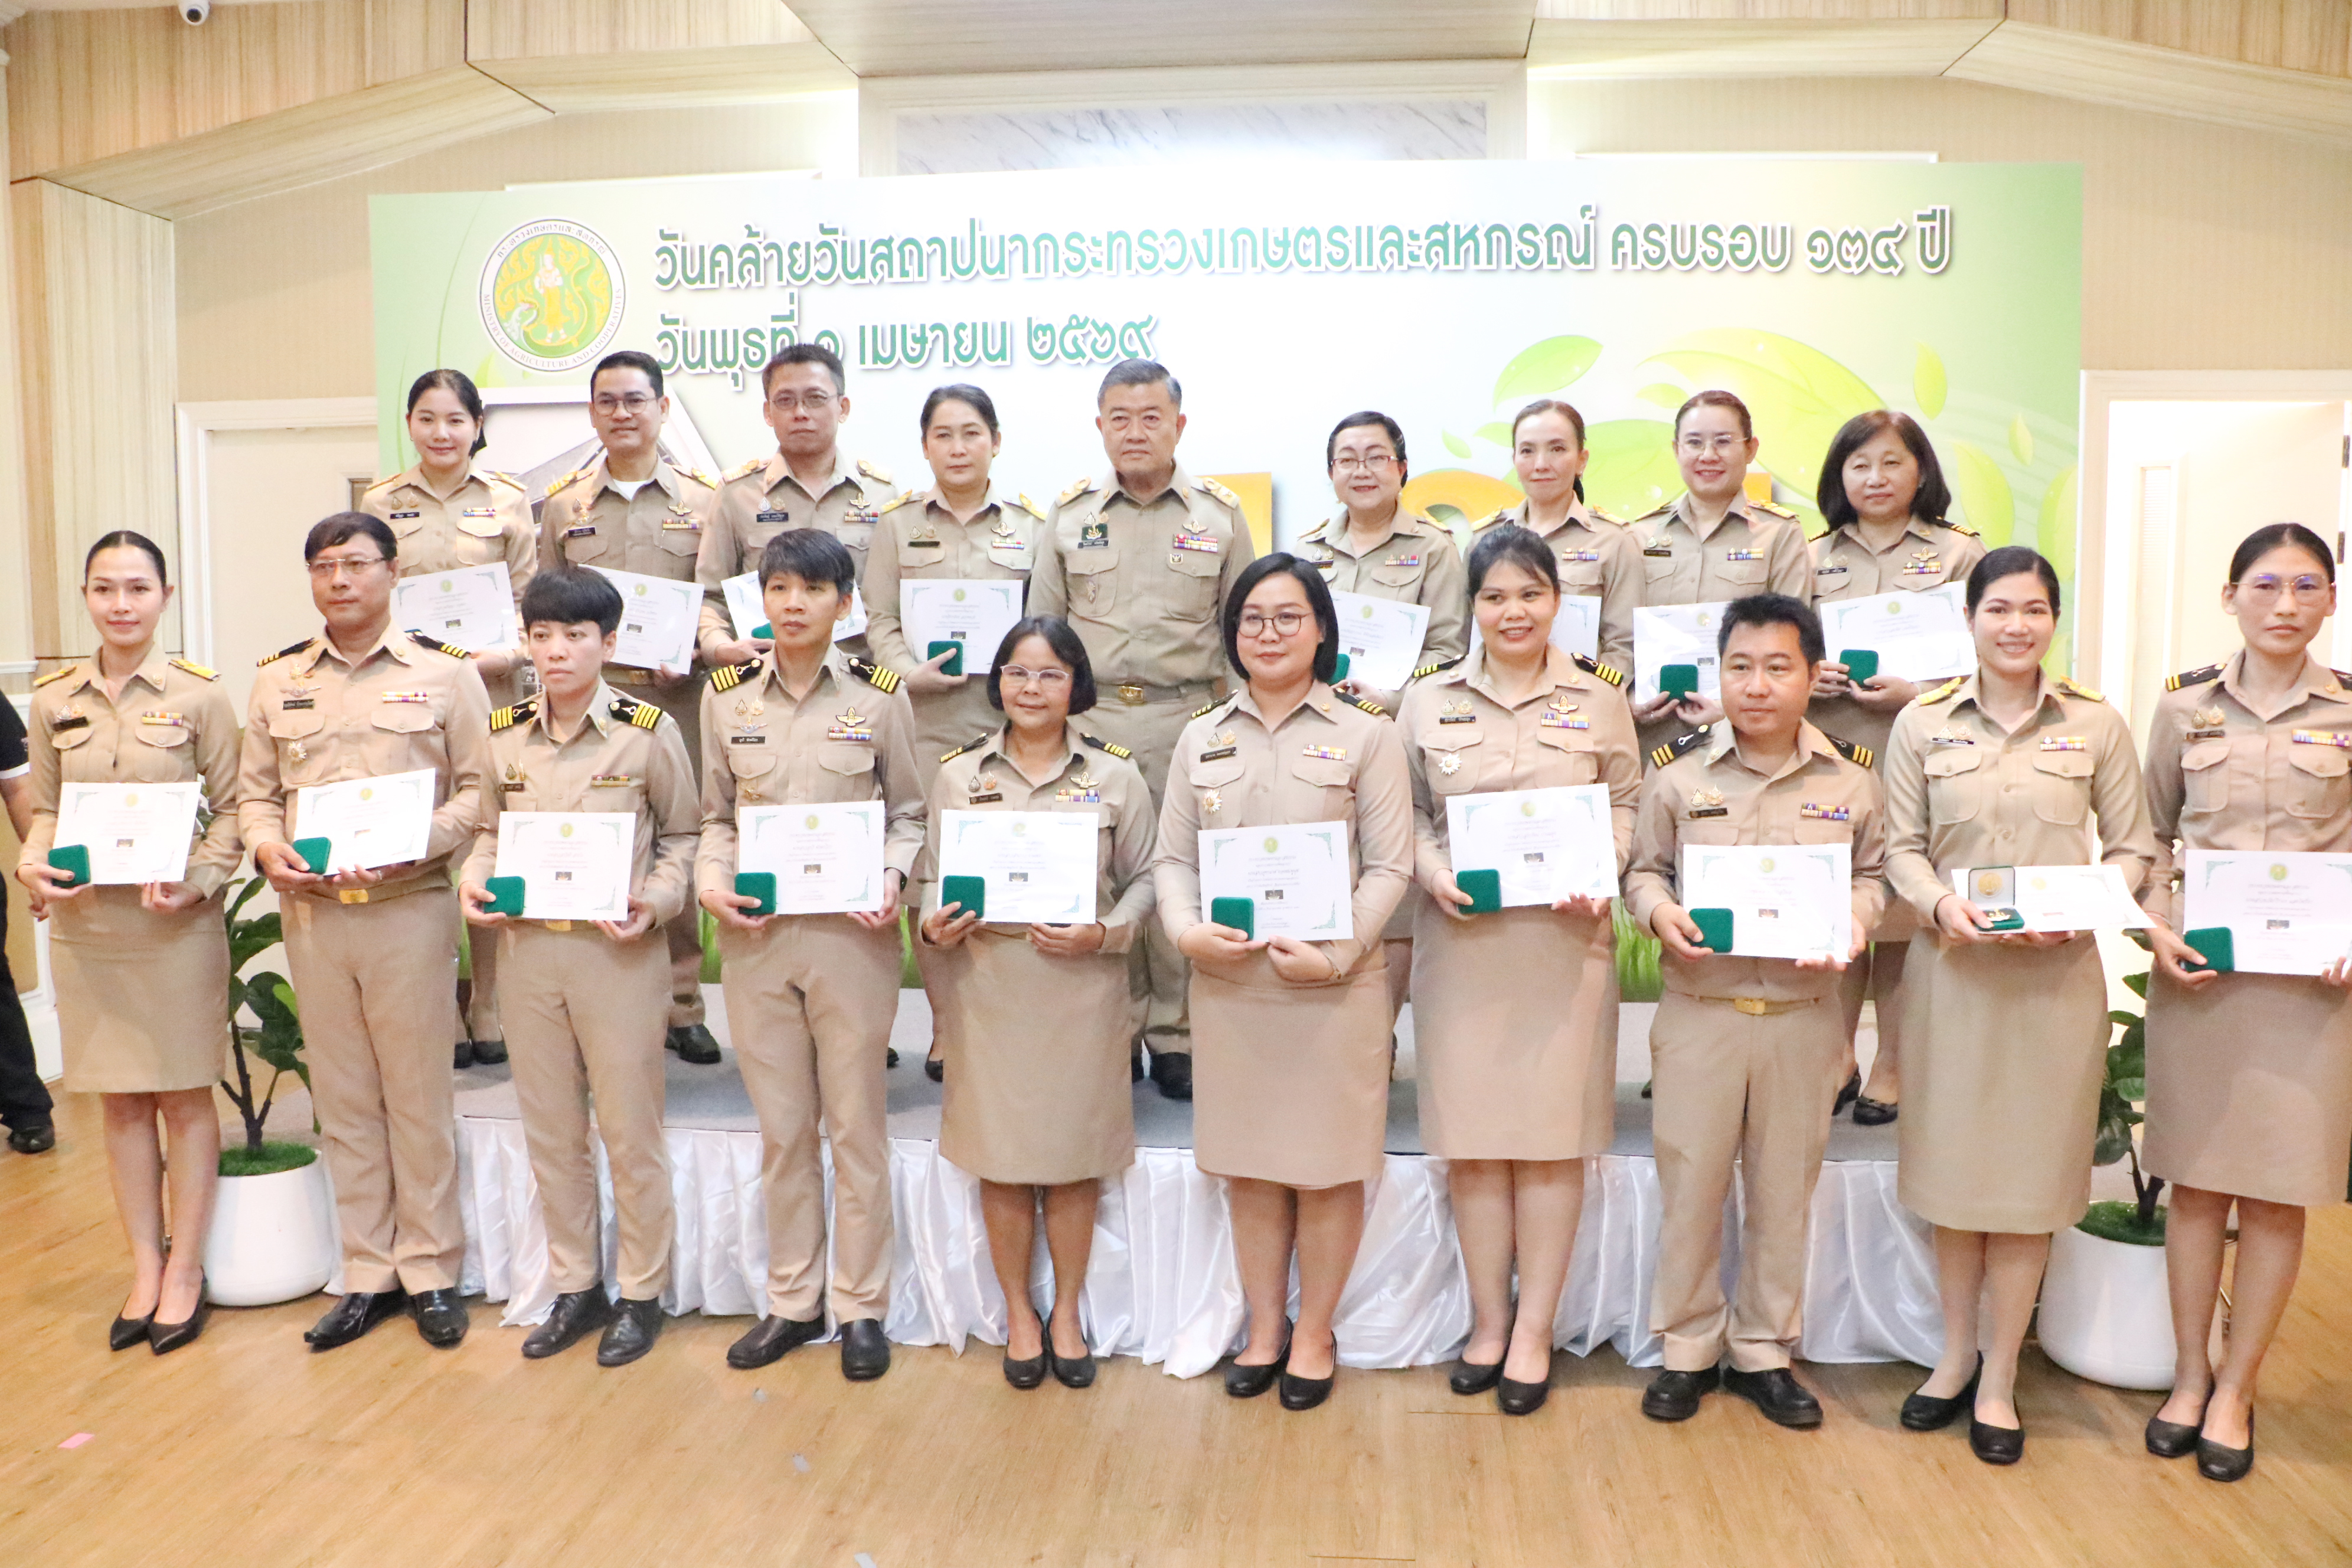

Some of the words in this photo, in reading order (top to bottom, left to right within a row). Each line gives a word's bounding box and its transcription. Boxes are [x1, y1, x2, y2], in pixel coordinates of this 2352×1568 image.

[654, 204, 1591, 287] วันคล้ายวันสถาปนากระทรวงเกษตรและสหกรณ์
[1611, 223, 1786, 268] ครบรอบ
[1806, 223, 1904, 270] ๑๓๔
[1916, 208, 1946, 269] ปี
[484, 294, 501, 338] MINISTRY
[499, 337, 511, 349] OF
[509, 347, 570, 368] AGRICULTURE
[571, 351, 590, 365] AND
[590, 288, 622, 354] COOPERATIVES
[859, 321, 1007, 365] เมษายน
[1027, 313, 1154, 360] ๒๕๖๙
